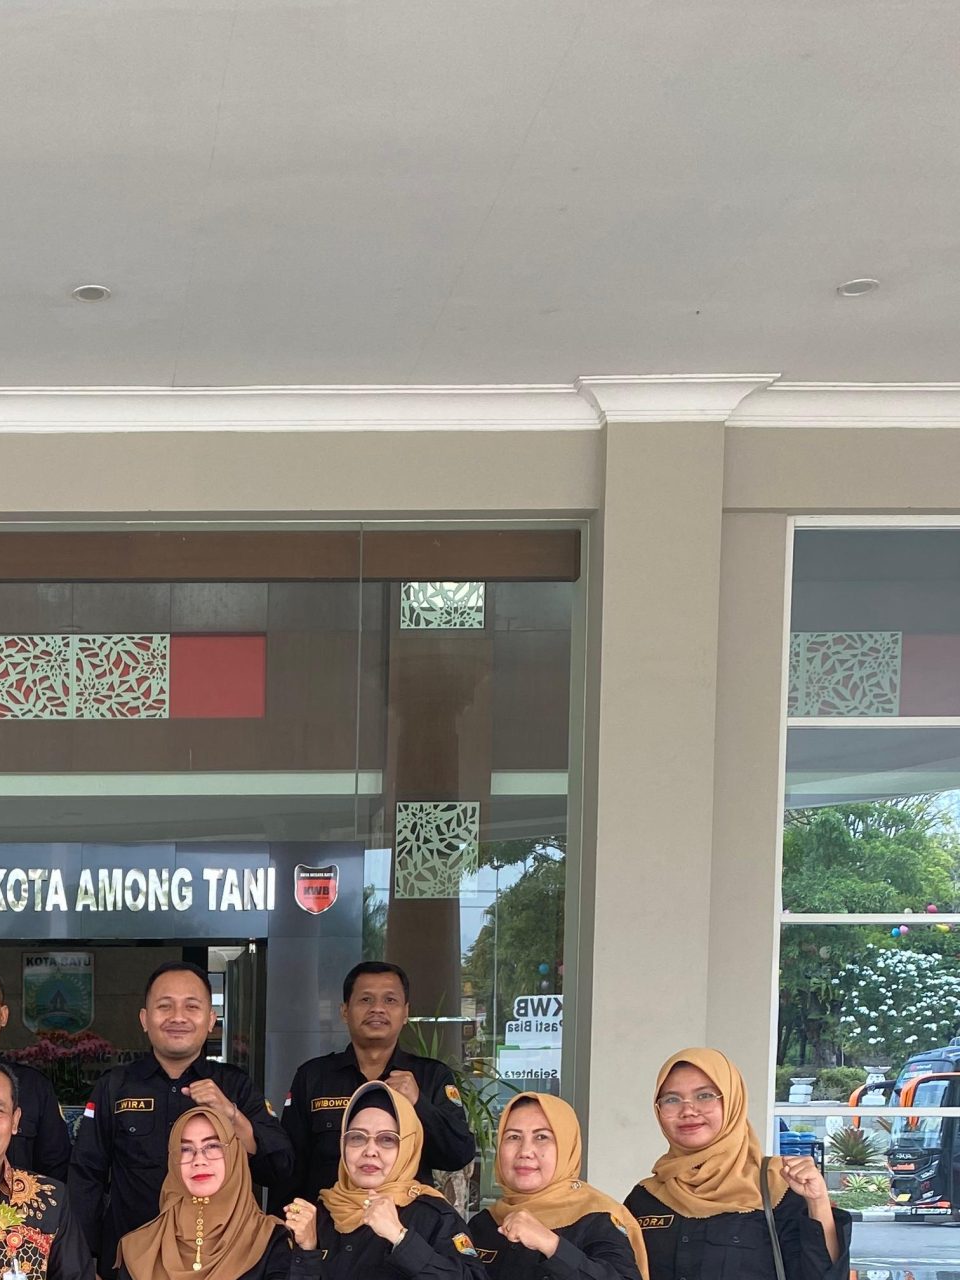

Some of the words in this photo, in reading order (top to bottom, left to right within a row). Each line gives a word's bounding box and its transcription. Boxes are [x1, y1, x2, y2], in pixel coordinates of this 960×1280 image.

[75, 867, 193, 913] AMONG
[203, 867, 276, 912] TANI
[26, 956, 58, 967] KOTA
[120, 1100, 146, 1109] WIRA
